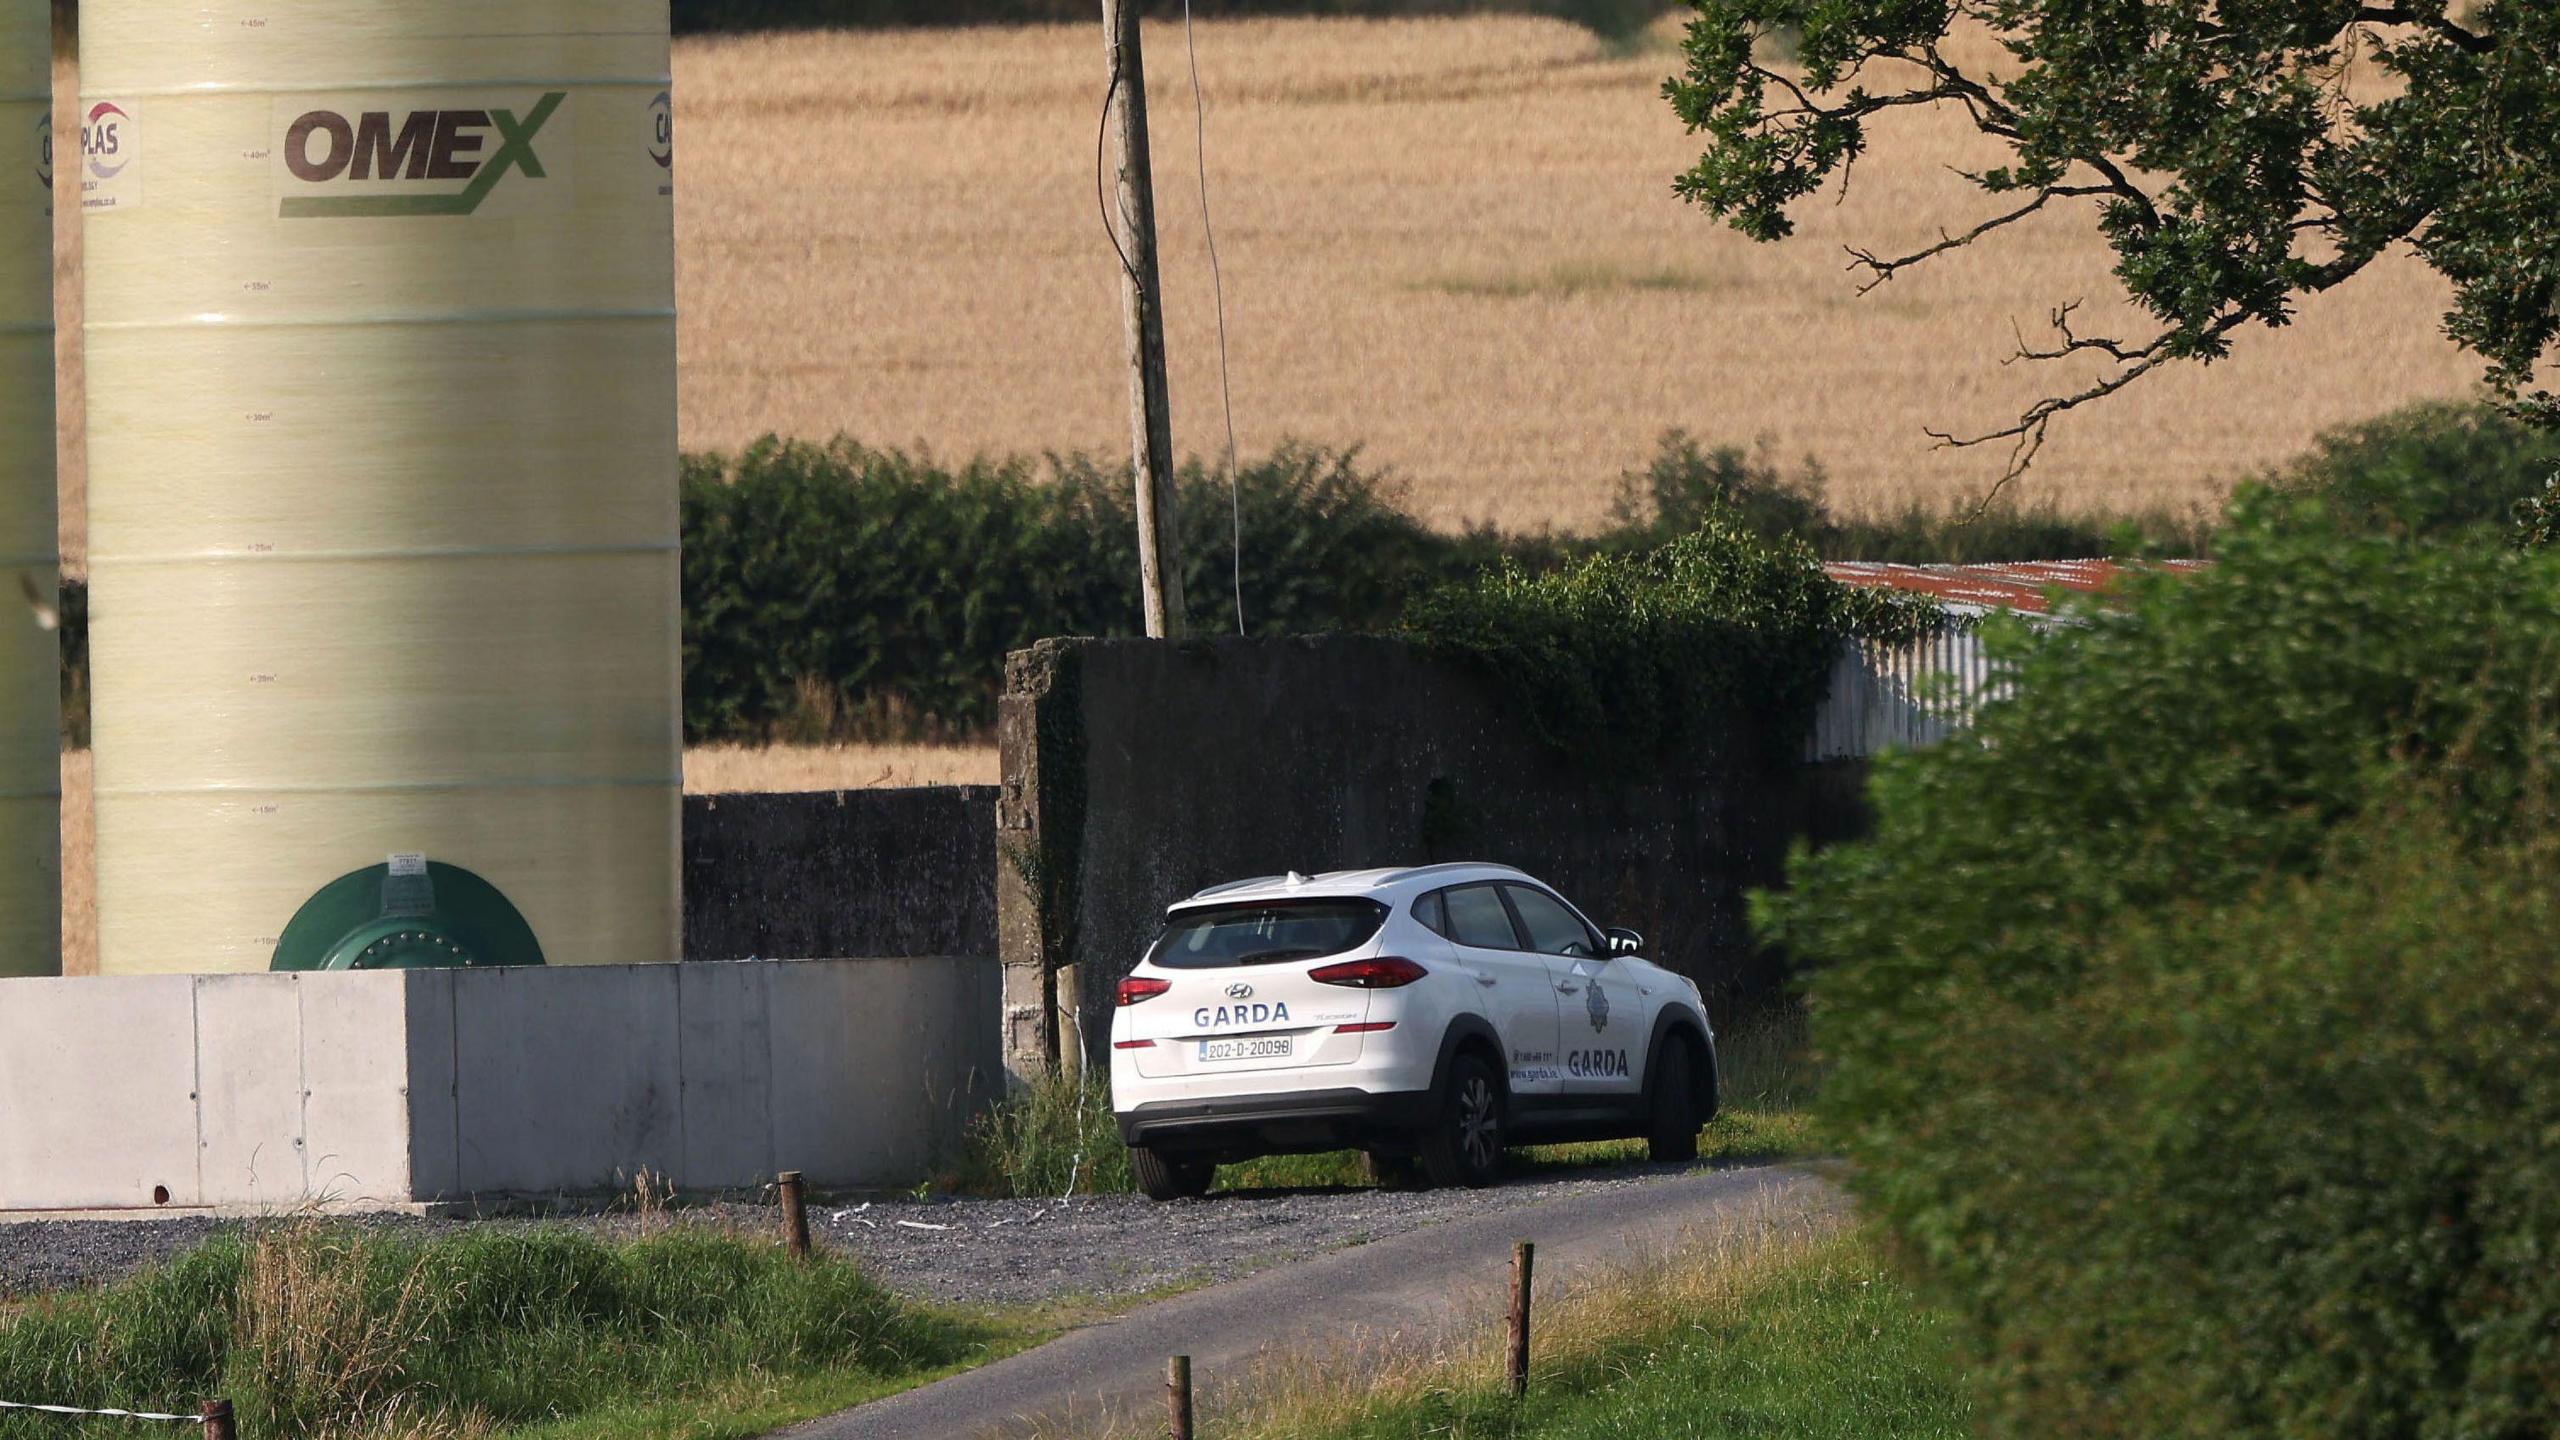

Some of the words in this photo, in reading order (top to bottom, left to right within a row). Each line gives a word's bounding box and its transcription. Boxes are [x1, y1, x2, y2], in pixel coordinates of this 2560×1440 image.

[284, 91, 567, 182] OMEX
[1193, 1001, 1290, 1028] GARDA
[1567, 1048, 1629, 1078] GARDA
